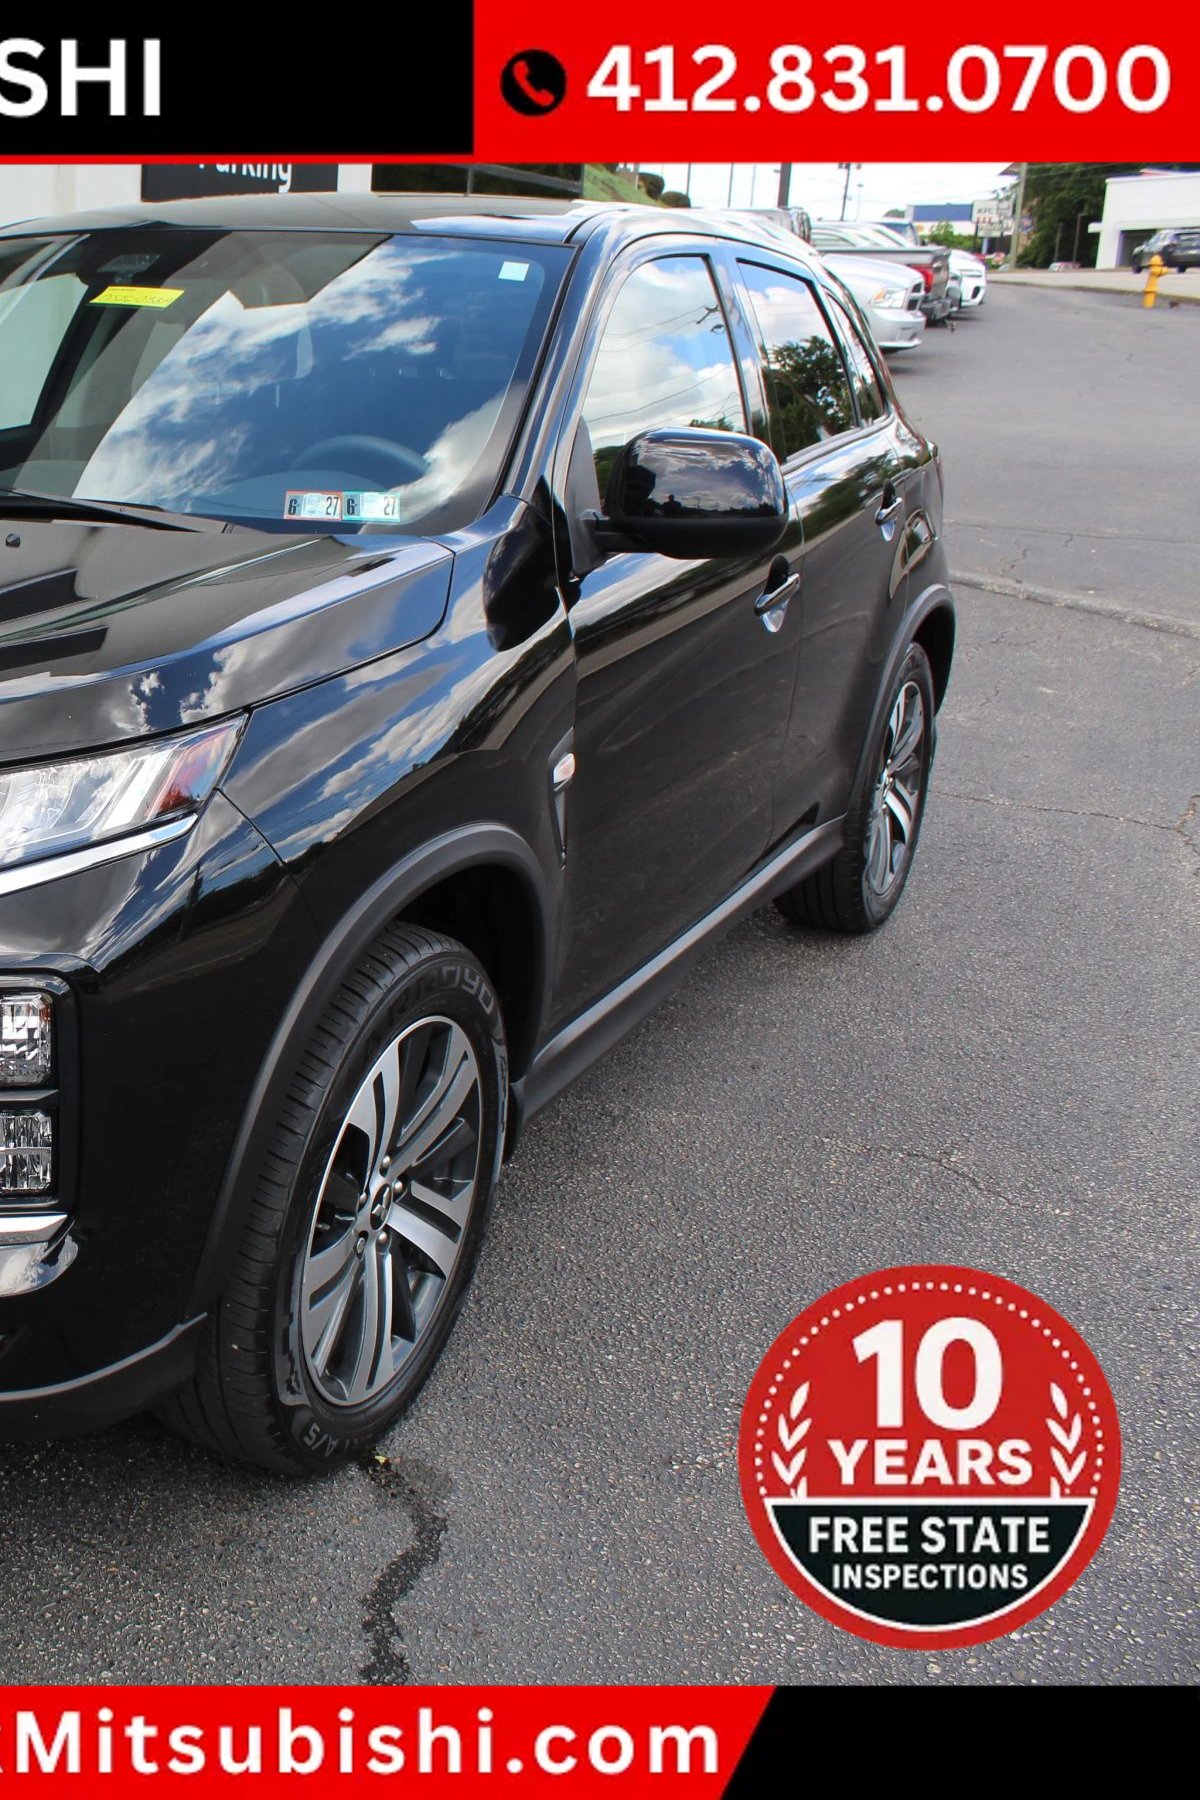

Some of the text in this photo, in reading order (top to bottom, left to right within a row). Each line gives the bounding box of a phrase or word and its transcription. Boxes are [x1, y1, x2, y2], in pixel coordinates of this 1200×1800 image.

[287, 496, 339, 518] 6 27
[346, 496, 396, 517] 6 27
